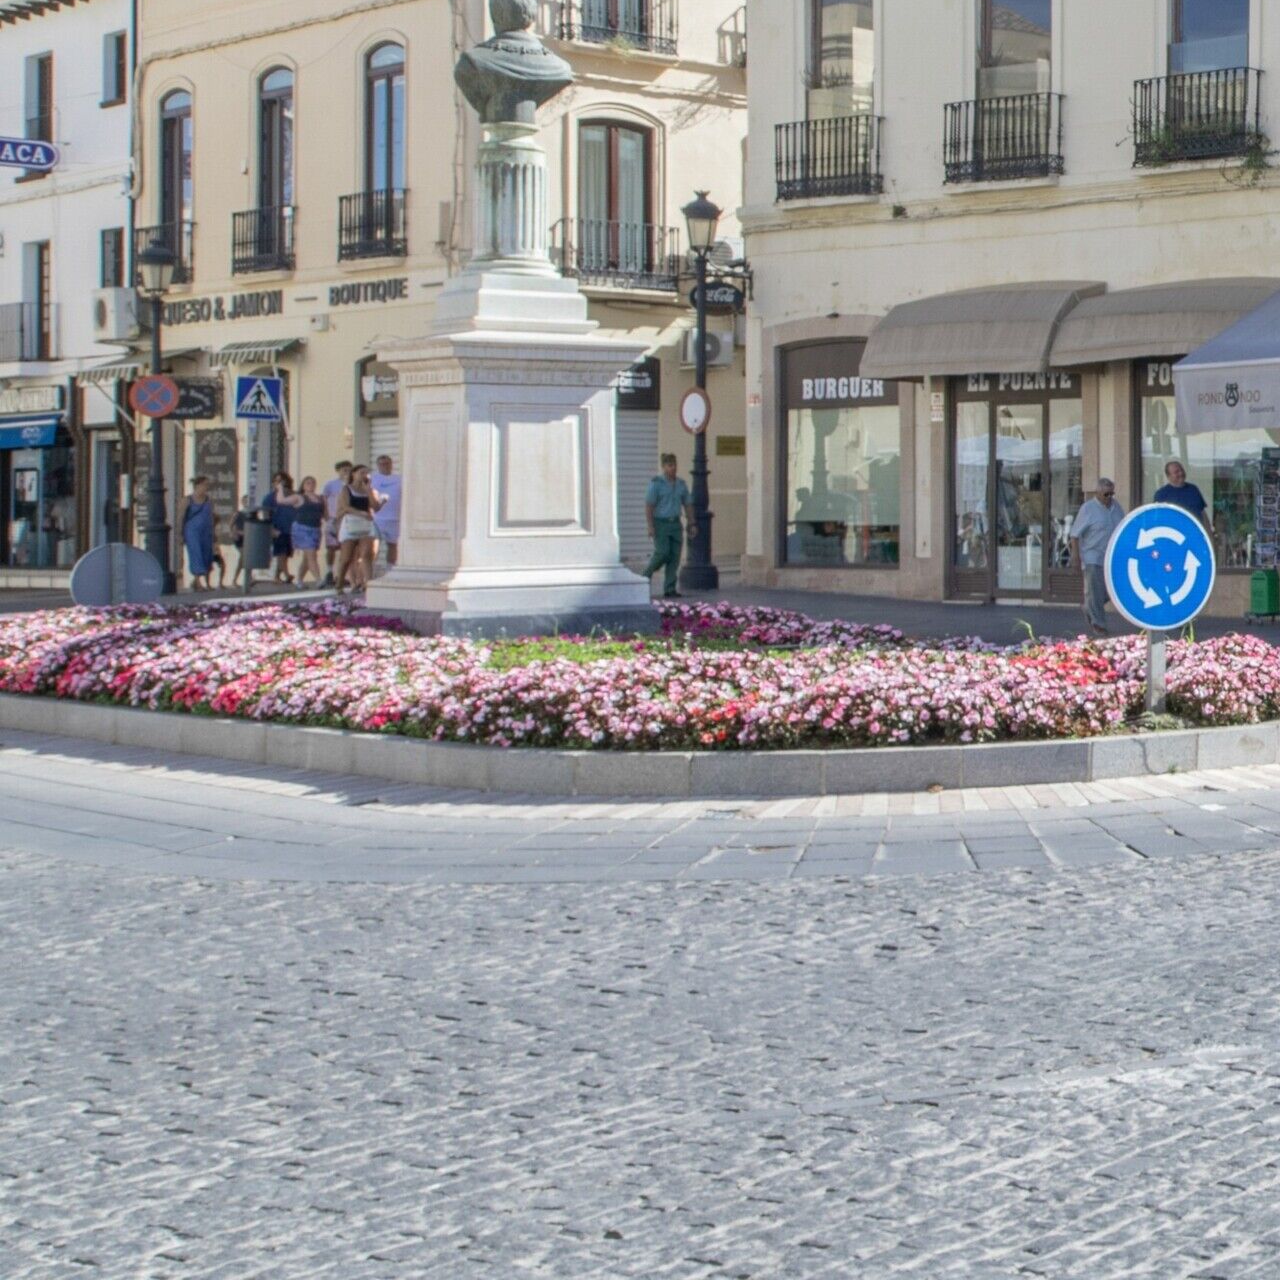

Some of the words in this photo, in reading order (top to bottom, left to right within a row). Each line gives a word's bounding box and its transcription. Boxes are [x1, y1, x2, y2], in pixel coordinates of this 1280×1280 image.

[214, 297, 226, 320] &
[329, 278, 409, 306] BOUTIQUE
[967, 372, 990, 393] EL
[998, 371, 1072, 392] PUENTE
[1147, 363, 1174, 387] FO
[802, 376, 884, 401] BURGUER
